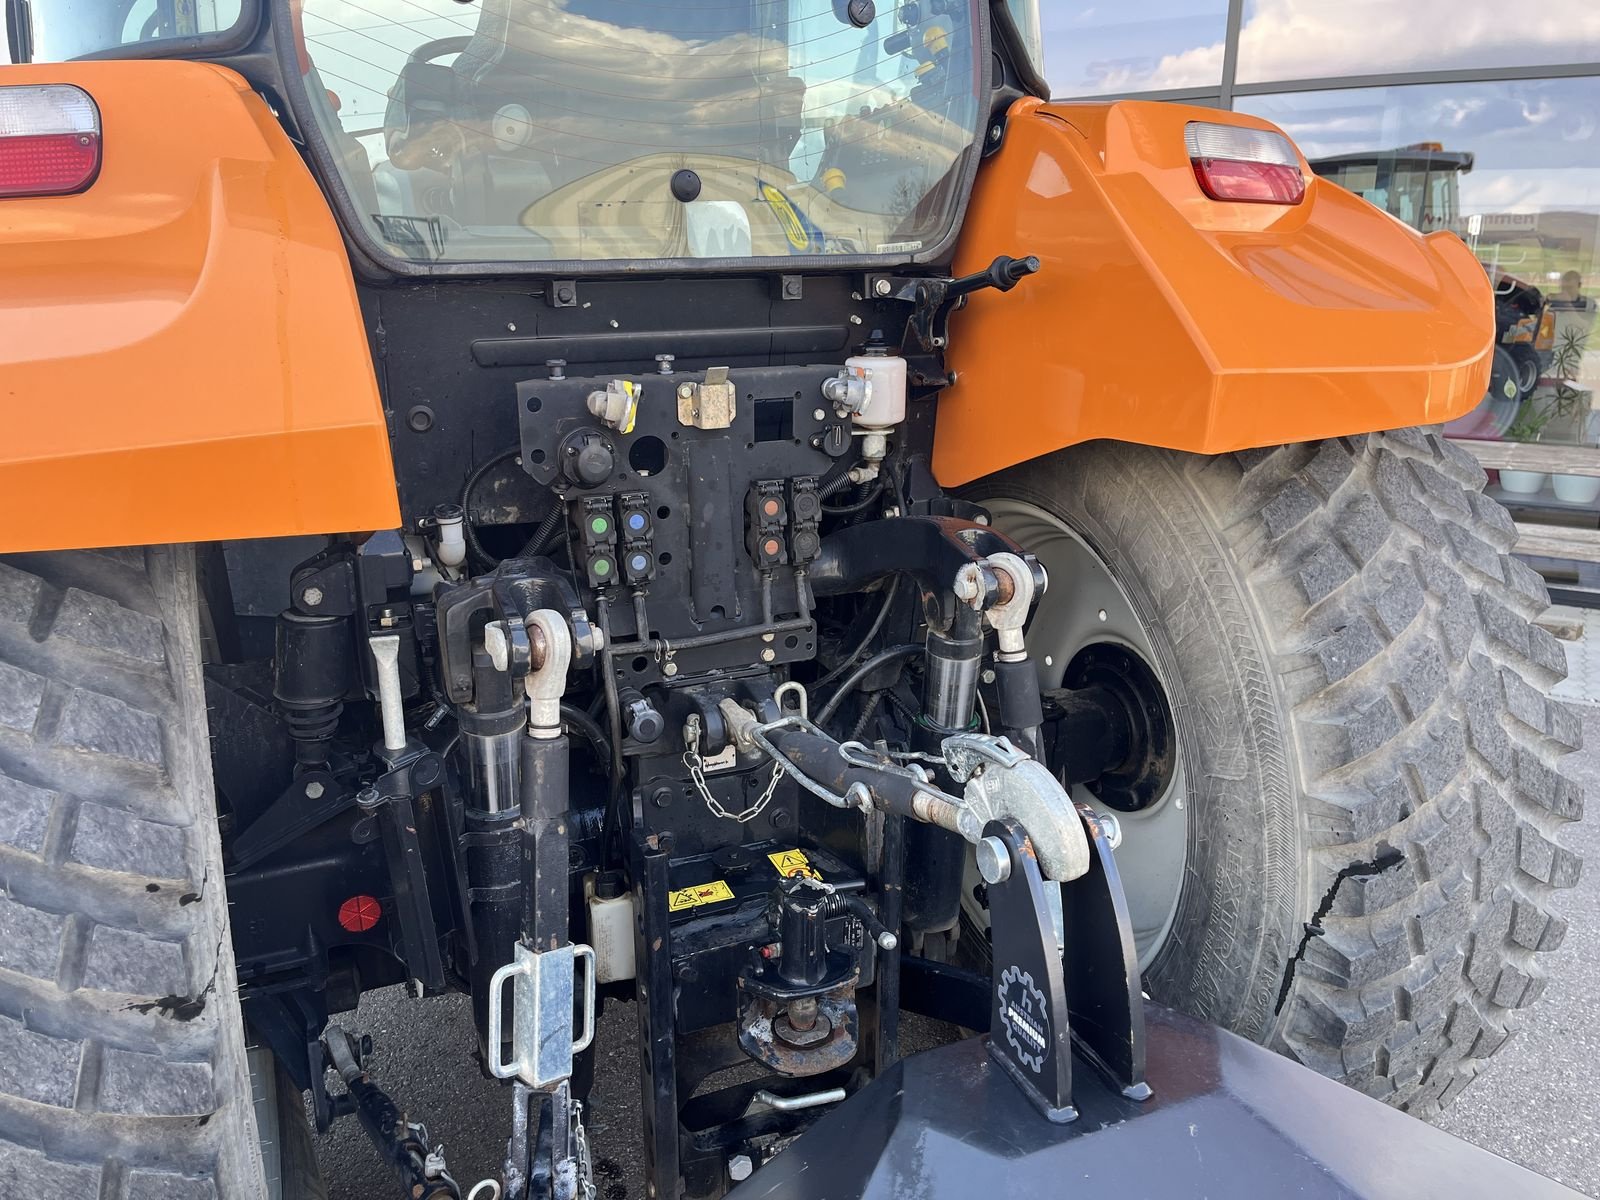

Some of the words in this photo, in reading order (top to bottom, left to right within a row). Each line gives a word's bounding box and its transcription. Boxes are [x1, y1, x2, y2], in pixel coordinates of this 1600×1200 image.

[1008, 1006, 1046, 1049] PREMIUM
[1010, 1000, 1044, 1035] AUSTRIAN
[1012, 1021, 1042, 1054] QUALITY
